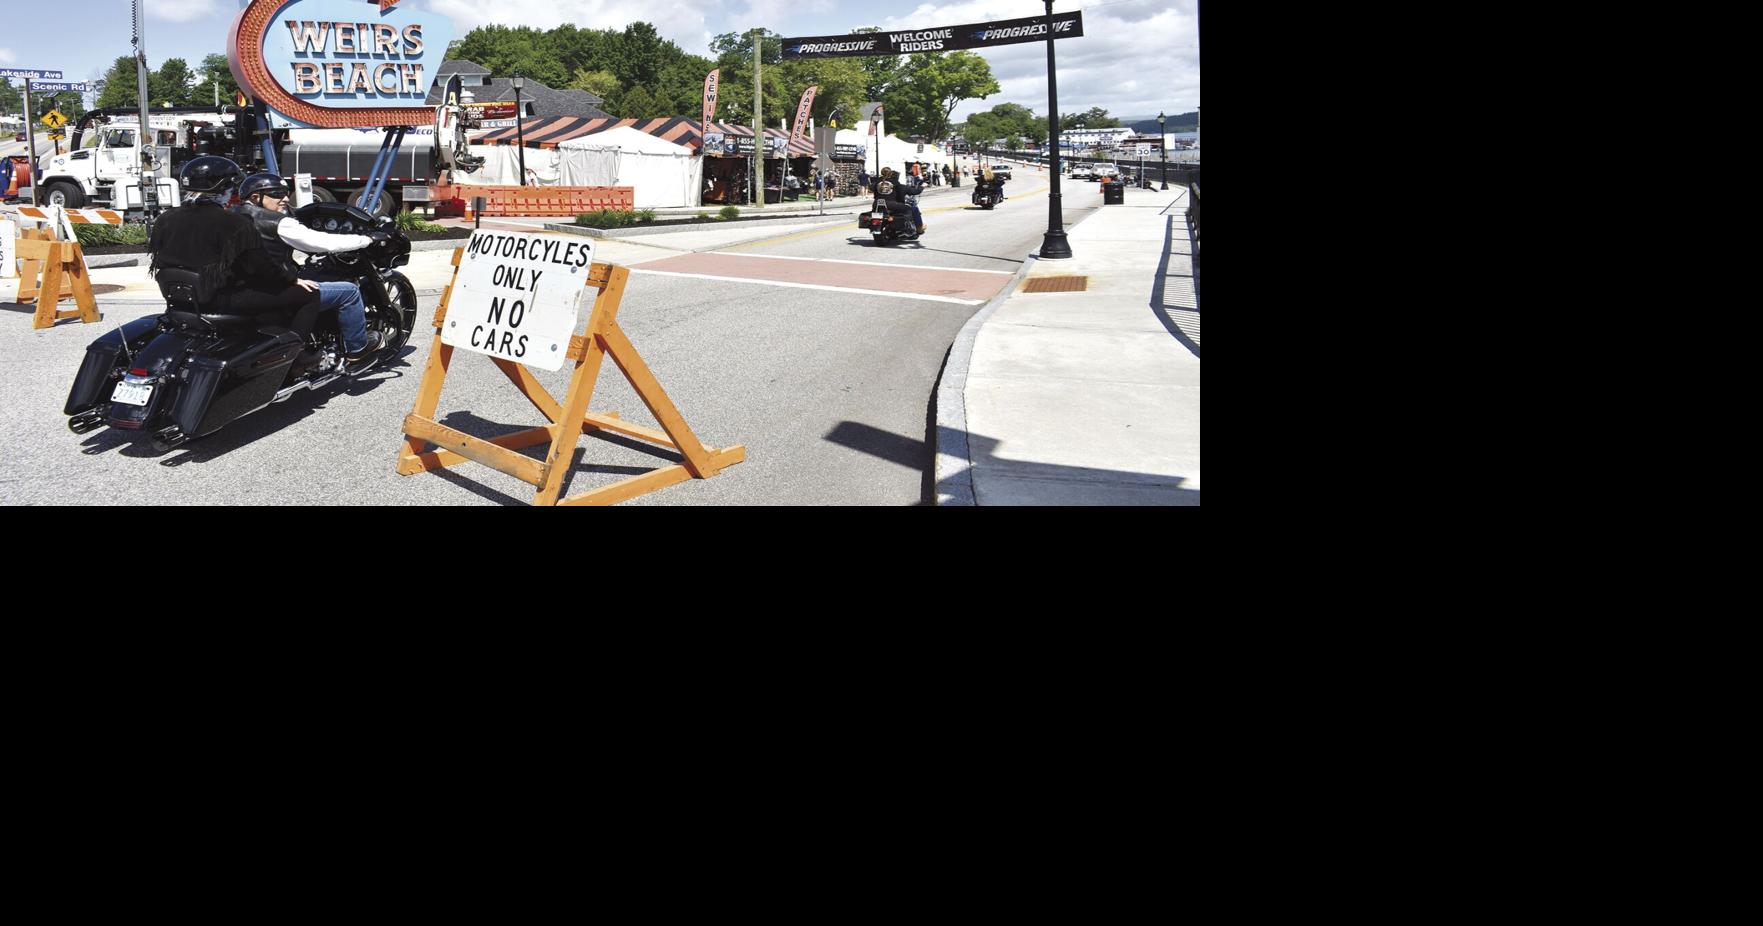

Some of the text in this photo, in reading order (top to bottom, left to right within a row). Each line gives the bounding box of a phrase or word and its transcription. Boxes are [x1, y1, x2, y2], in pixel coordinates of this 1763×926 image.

[285, 20, 424, 59] WEIRS
[889, 28, 953, 43] WELCOME
[983, 20, 1074, 40] PROGRESIVE
[798, 40, 875, 54] PROGRESSIVE
[900, 40, 944, 52] RIDERS
[32, 82, 85, 91] Scenic Rd
[43, 71, 61, 79] Ave
[291, 62, 425, 99] BEACH
[794, 90, 812, 139] PATCHES
[467, 233, 591, 268] MOTORCYLES
[492, 264, 543, 292] ONLY
[487, 296, 525, 329] NO
[471, 325, 529, 358] CARS
